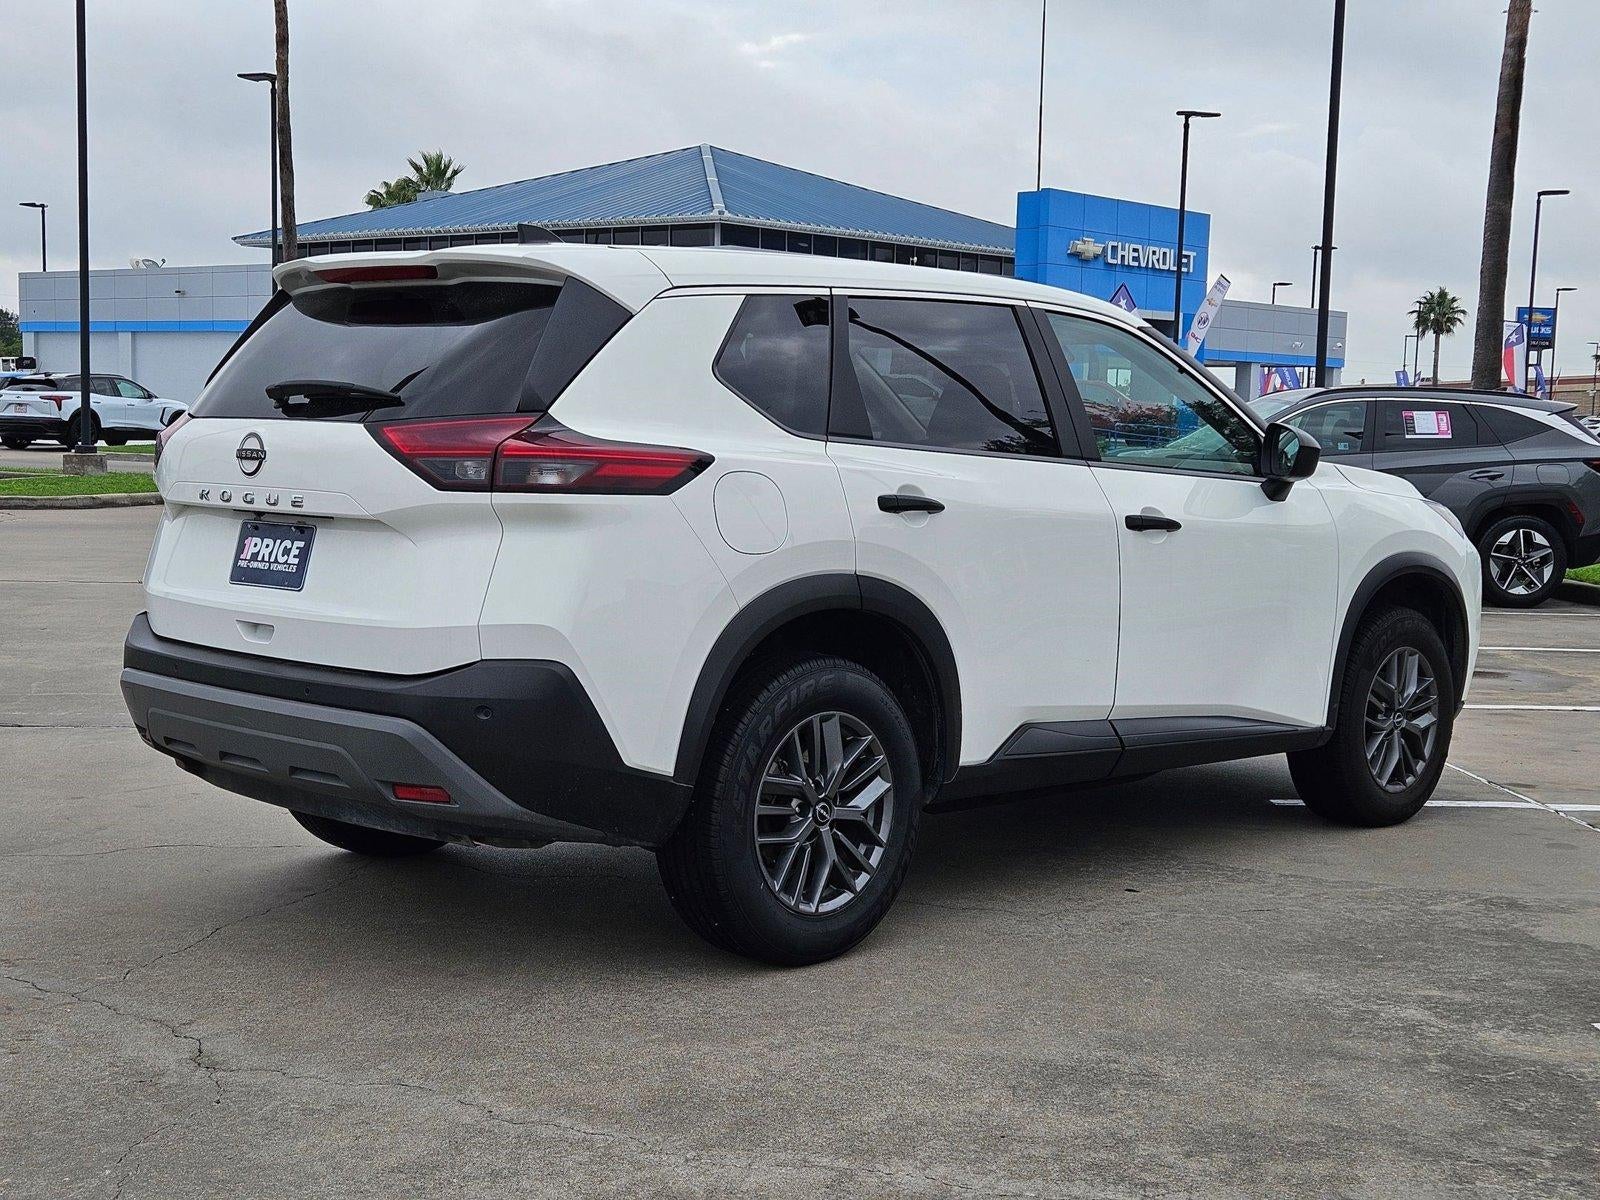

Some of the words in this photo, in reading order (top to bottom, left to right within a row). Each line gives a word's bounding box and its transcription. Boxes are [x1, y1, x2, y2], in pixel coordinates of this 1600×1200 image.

[1106, 240, 1197, 273] CHEVROLET
[236, 449, 265, 459] NISSAN
[199, 488, 305, 509] ROGUE
[239, 536, 305, 565] 1PRICE
[237, 559, 270, 571] PRE-OWNED
[270, 562, 298, 573] VEHICLES
